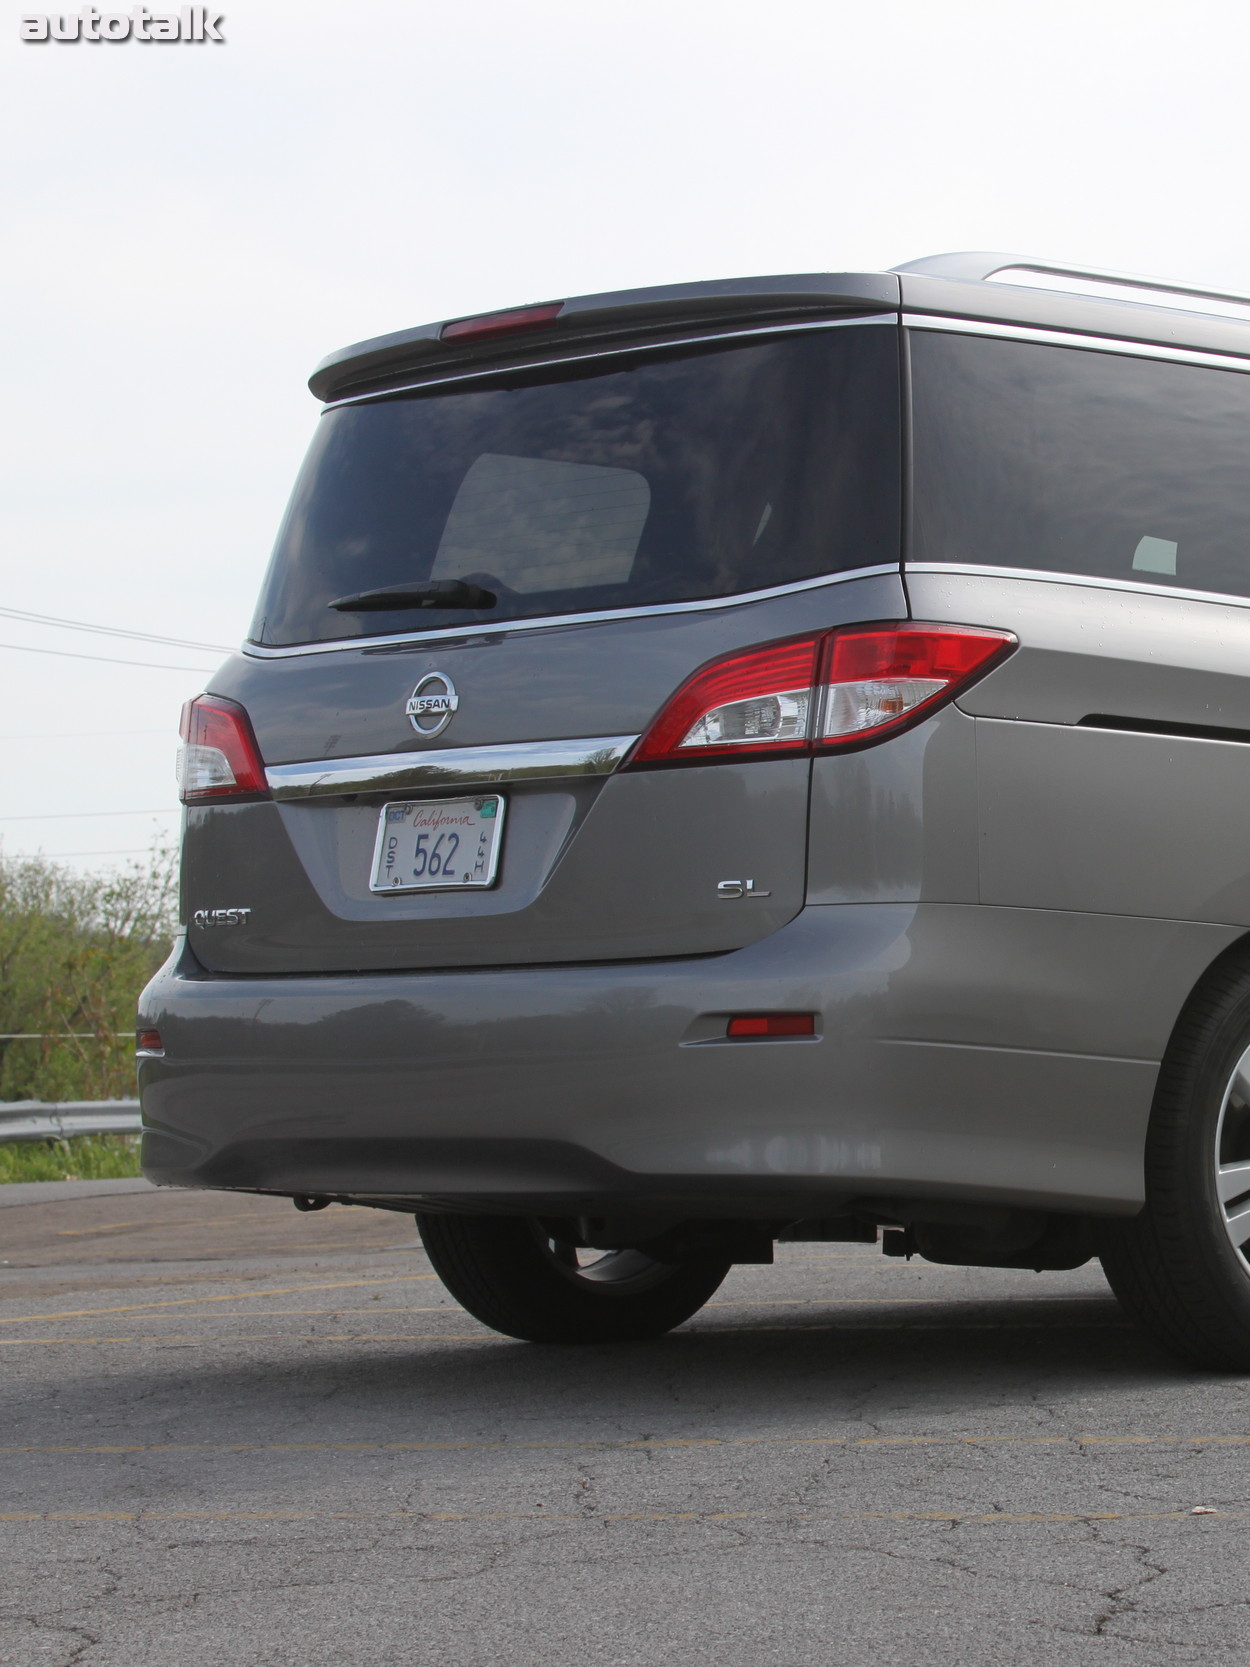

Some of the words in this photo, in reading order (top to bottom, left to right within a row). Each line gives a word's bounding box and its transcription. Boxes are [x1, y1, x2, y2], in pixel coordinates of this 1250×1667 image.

[408, 698, 451, 712] NISSAN
[412, 809, 476, 831] California
[412, 832, 460, 877] 562
[717, 879, 771, 900] SL
[193, 908, 252, 930] QUEST
